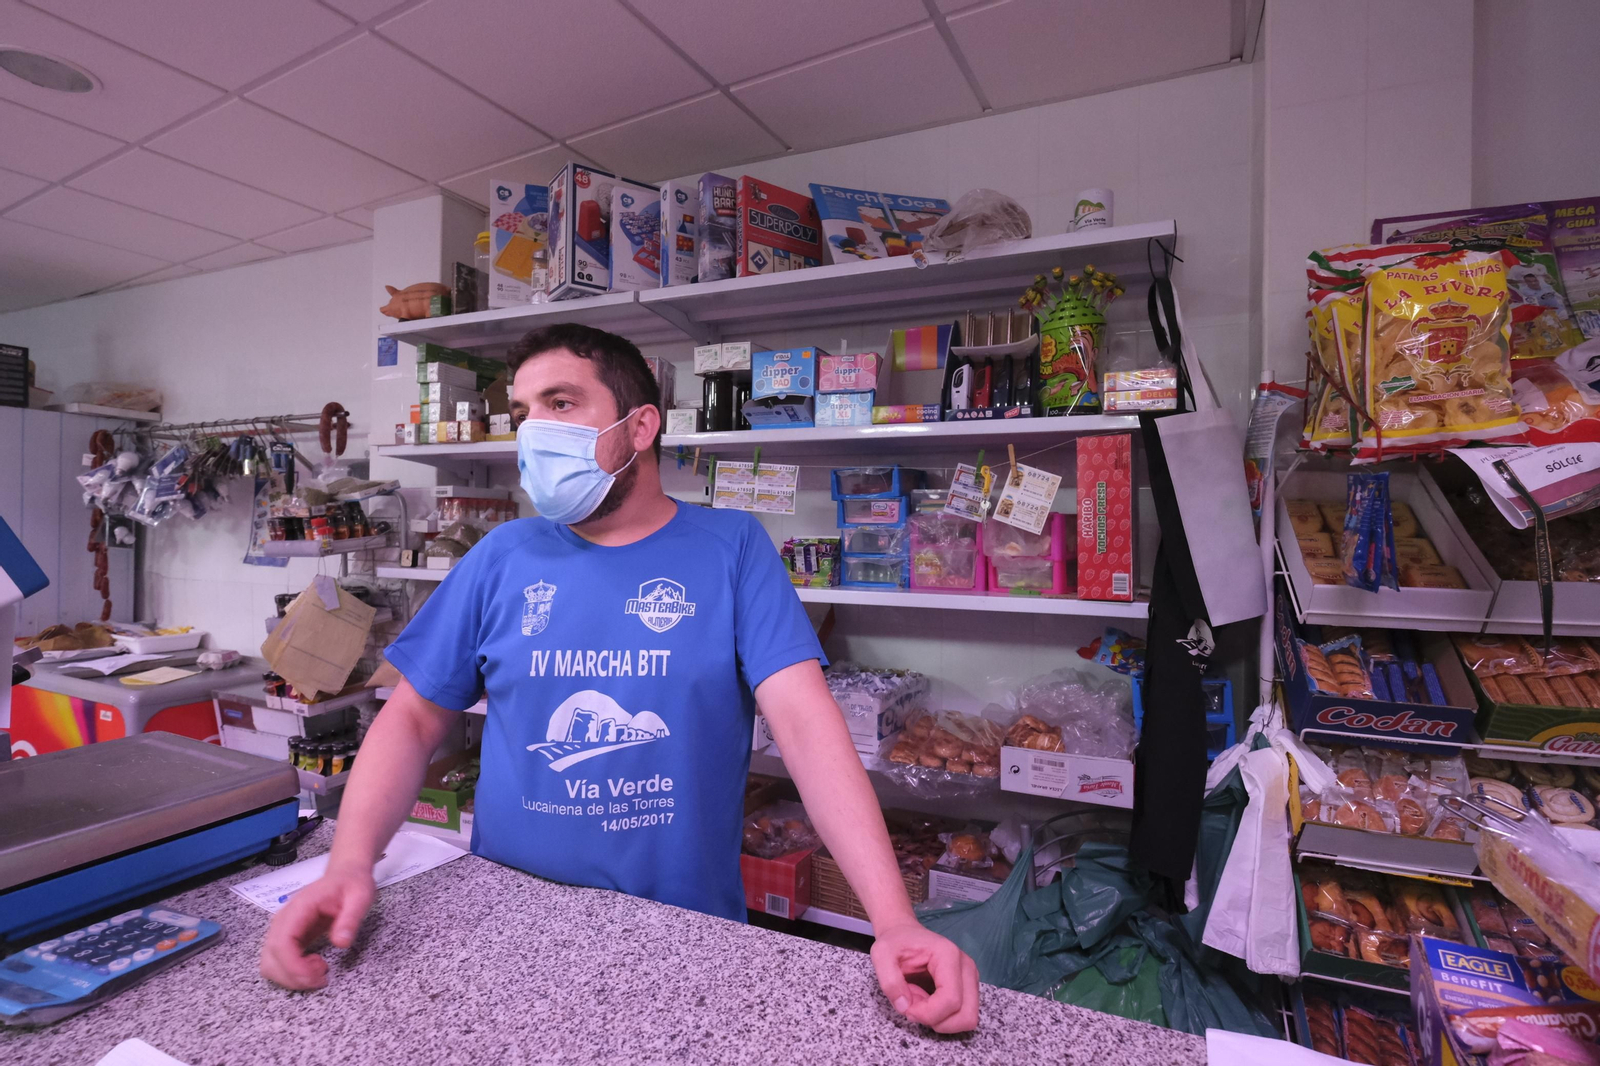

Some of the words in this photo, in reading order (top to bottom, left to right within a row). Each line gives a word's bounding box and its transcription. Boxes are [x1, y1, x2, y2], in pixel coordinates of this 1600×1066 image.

[576, 174, 589, 184] 48
[898, 197, 936, 209] Oca
[1555, 206, 1596, 217] MEGA
[751, 211, 813, 240] SUPERPOLY
[1465, 239, 1503, 247] Santander
[1387, 271, 1439, 282] PATATAS
[1459, 264, 1502, 278] FRITAS
[1384, 290, 1412, 310] LA
[1423, 281, 1506, 302] RIVERA
[762, 366, 800, 378] dipper
[835, 367, 861, 375] dipper
[773, 379, 790, 387] PAD
[1461, 388, 1485, 396] DIARIA
[831, 402, 858, 411] dipper
[1028, 471, 1050, 482] 68724
[1017, 500, 1039, 511] 68724
[1082, 497, 1094, 539] HARIBO
[1097, 518, 1107, 554] TOCHOS
[530, 650, 551, 677] IV
[554, 650, 632, 677] MARCHA
[638, 650, 671, 677] BTT
[1317, 707, 1458, 738] Codan
[565, 779, 600, 799] Vía
[607, 774, 674, 798] Verde
[522, 796, 582, 816] Lucainena
[587, 803, 604, 816] de
[609, 801, 629, 815] las
[632, 797, 675, 811] Torres
[601, 813, 674, 833] 14/05/2017
[1445, 954, 1506, 977] EAGLE
[1441, 972, 1502, 993] BeneFIT
